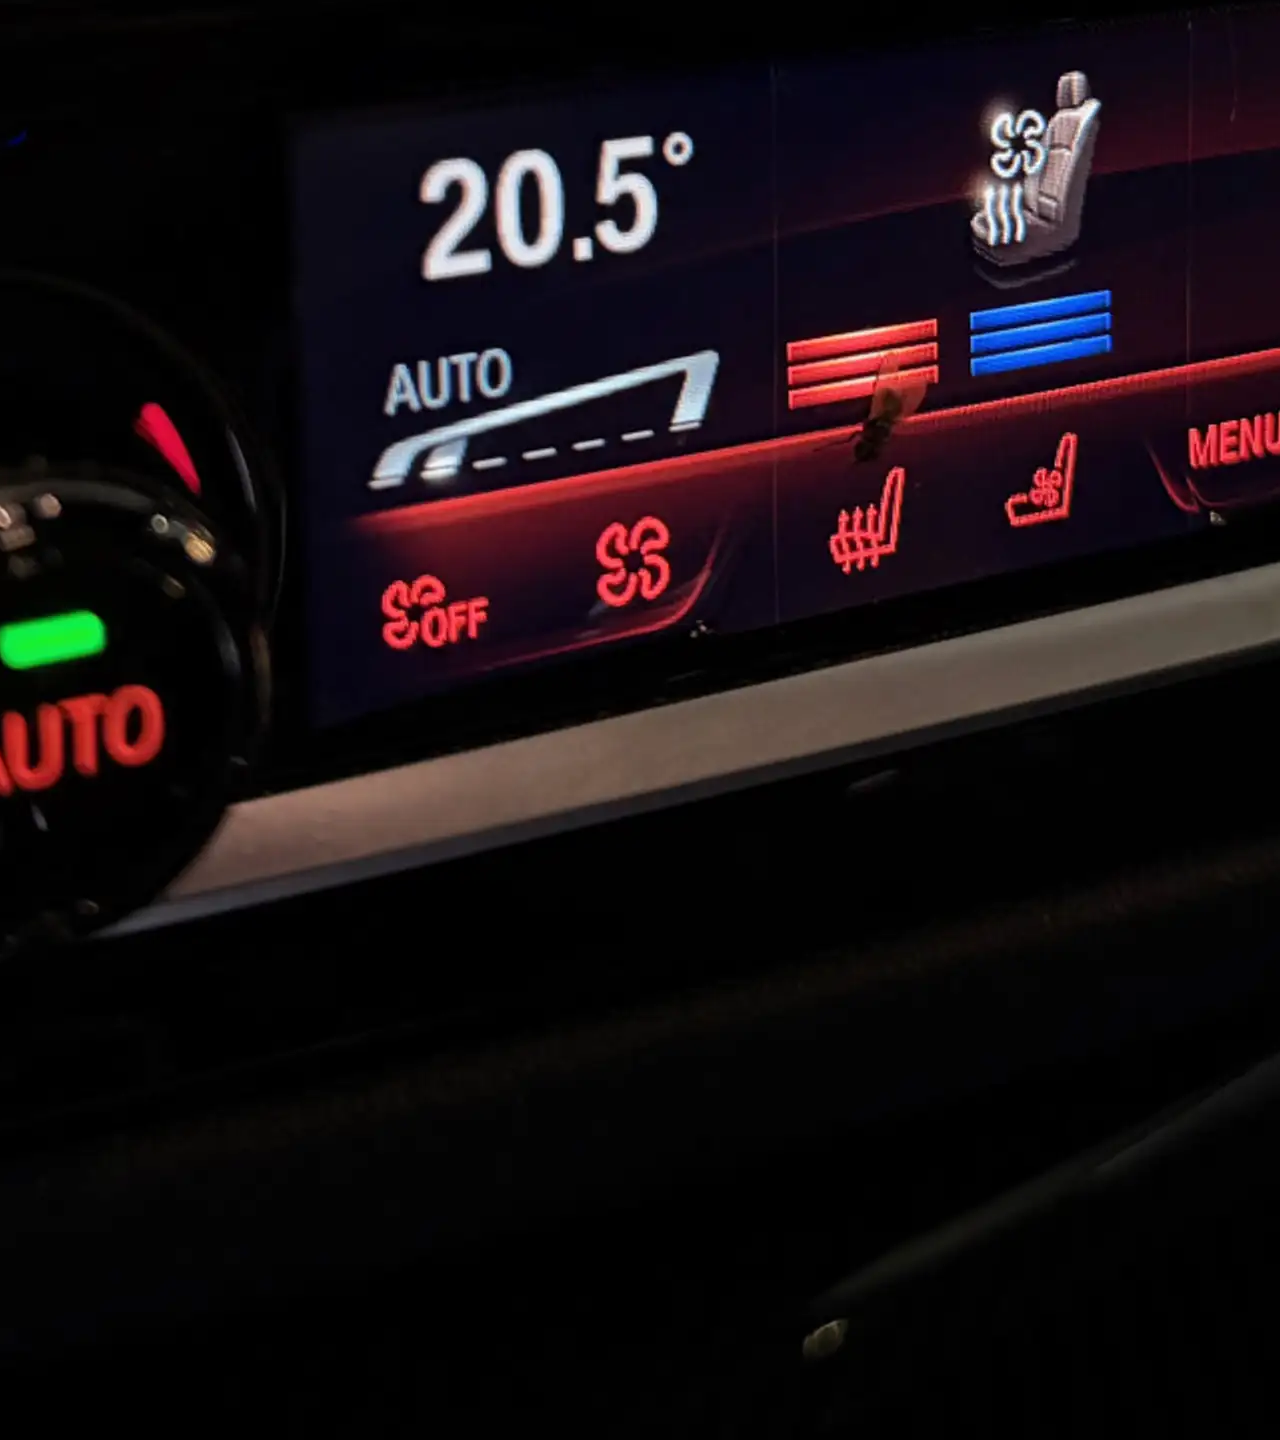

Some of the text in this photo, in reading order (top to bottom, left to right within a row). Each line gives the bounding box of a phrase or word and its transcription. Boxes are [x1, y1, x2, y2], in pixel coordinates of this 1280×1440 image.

[418, 130, 696, 283] 20.5°
[382, 346, 515, 418] AUTO
[420, 595, 491, 649] OFF
